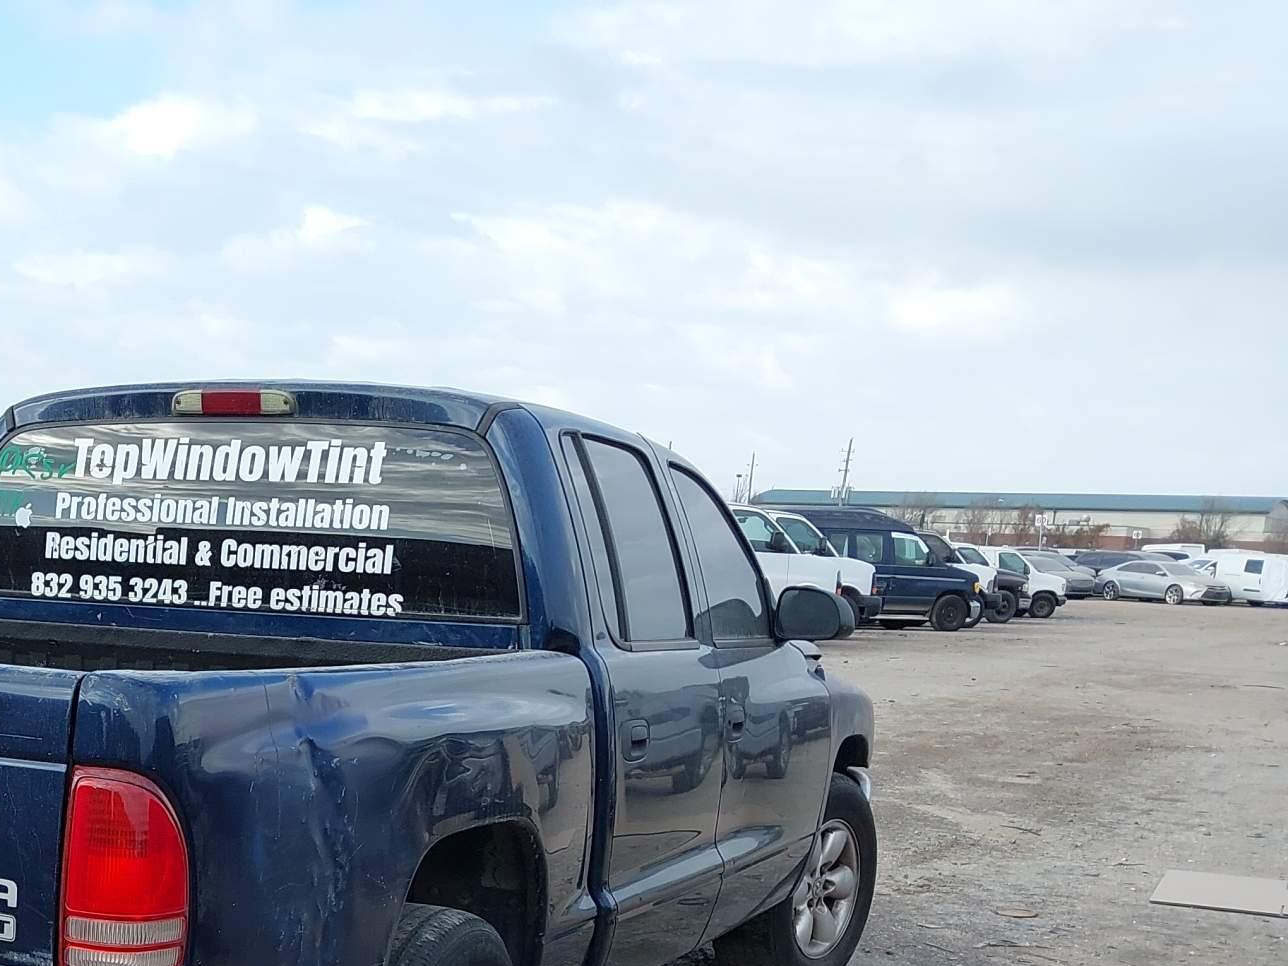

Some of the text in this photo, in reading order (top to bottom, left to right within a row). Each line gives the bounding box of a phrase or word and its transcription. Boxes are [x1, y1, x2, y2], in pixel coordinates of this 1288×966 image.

[74, 437, 387, 485] TopWindowTint
[55, 492, 390, 530] Professional Installation
[45, 531, 394, 575] Residential & Commercial
[30, 572, 72, 598] 832
[79, 575, 122, 600] 935
[128, 577, 188, 604] 3243
[269, 585, 404, 617] estimates
